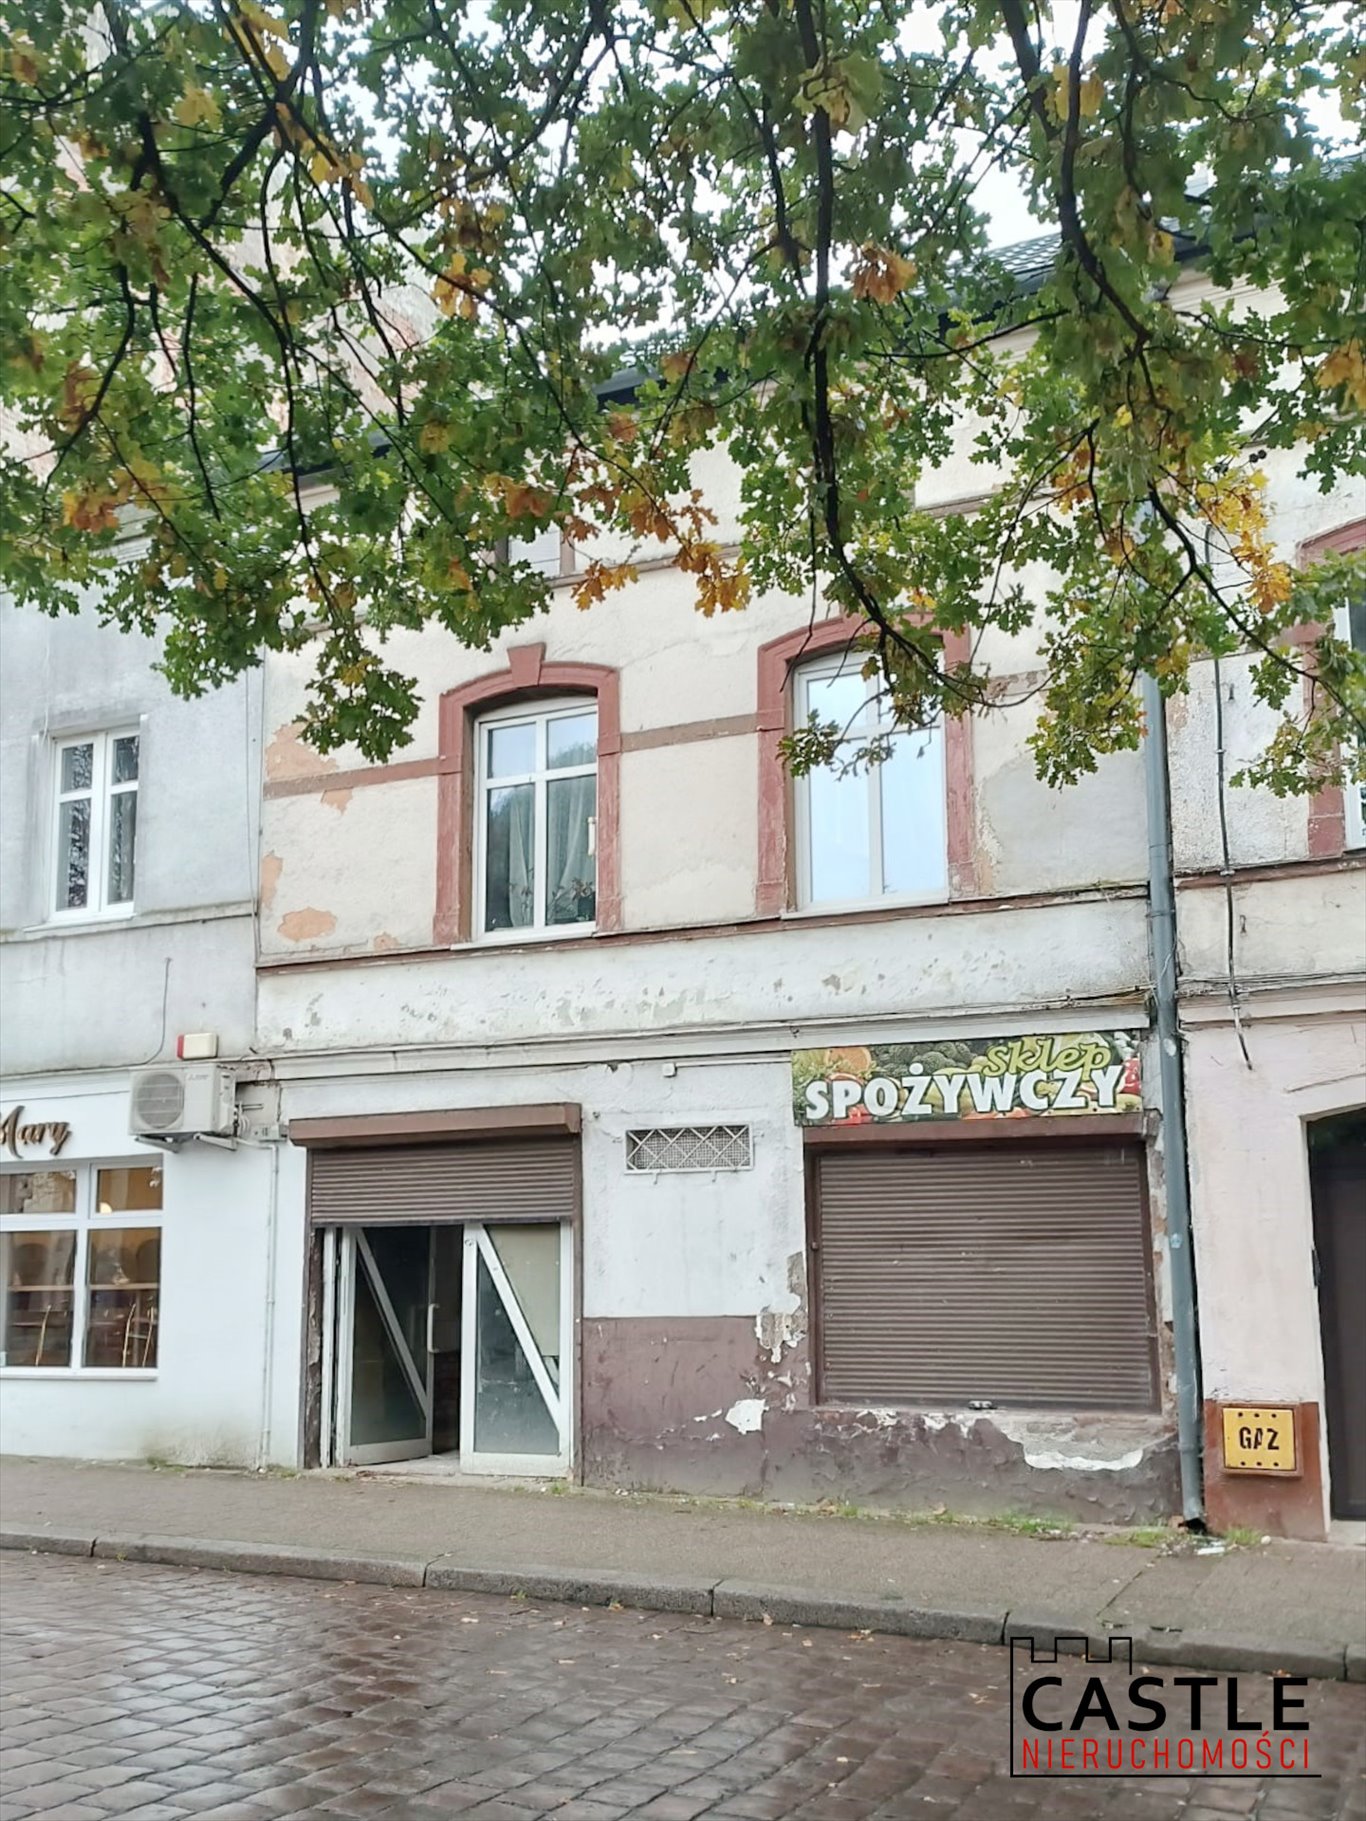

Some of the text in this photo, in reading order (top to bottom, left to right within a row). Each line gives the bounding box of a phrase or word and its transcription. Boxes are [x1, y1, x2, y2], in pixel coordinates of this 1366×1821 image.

[984, 1037, 1111, 1080] sklep
[805, 1062, 1122, 1119] SPOŻYWCZY
[1239, 1426, 1280, 1450] GAZ
